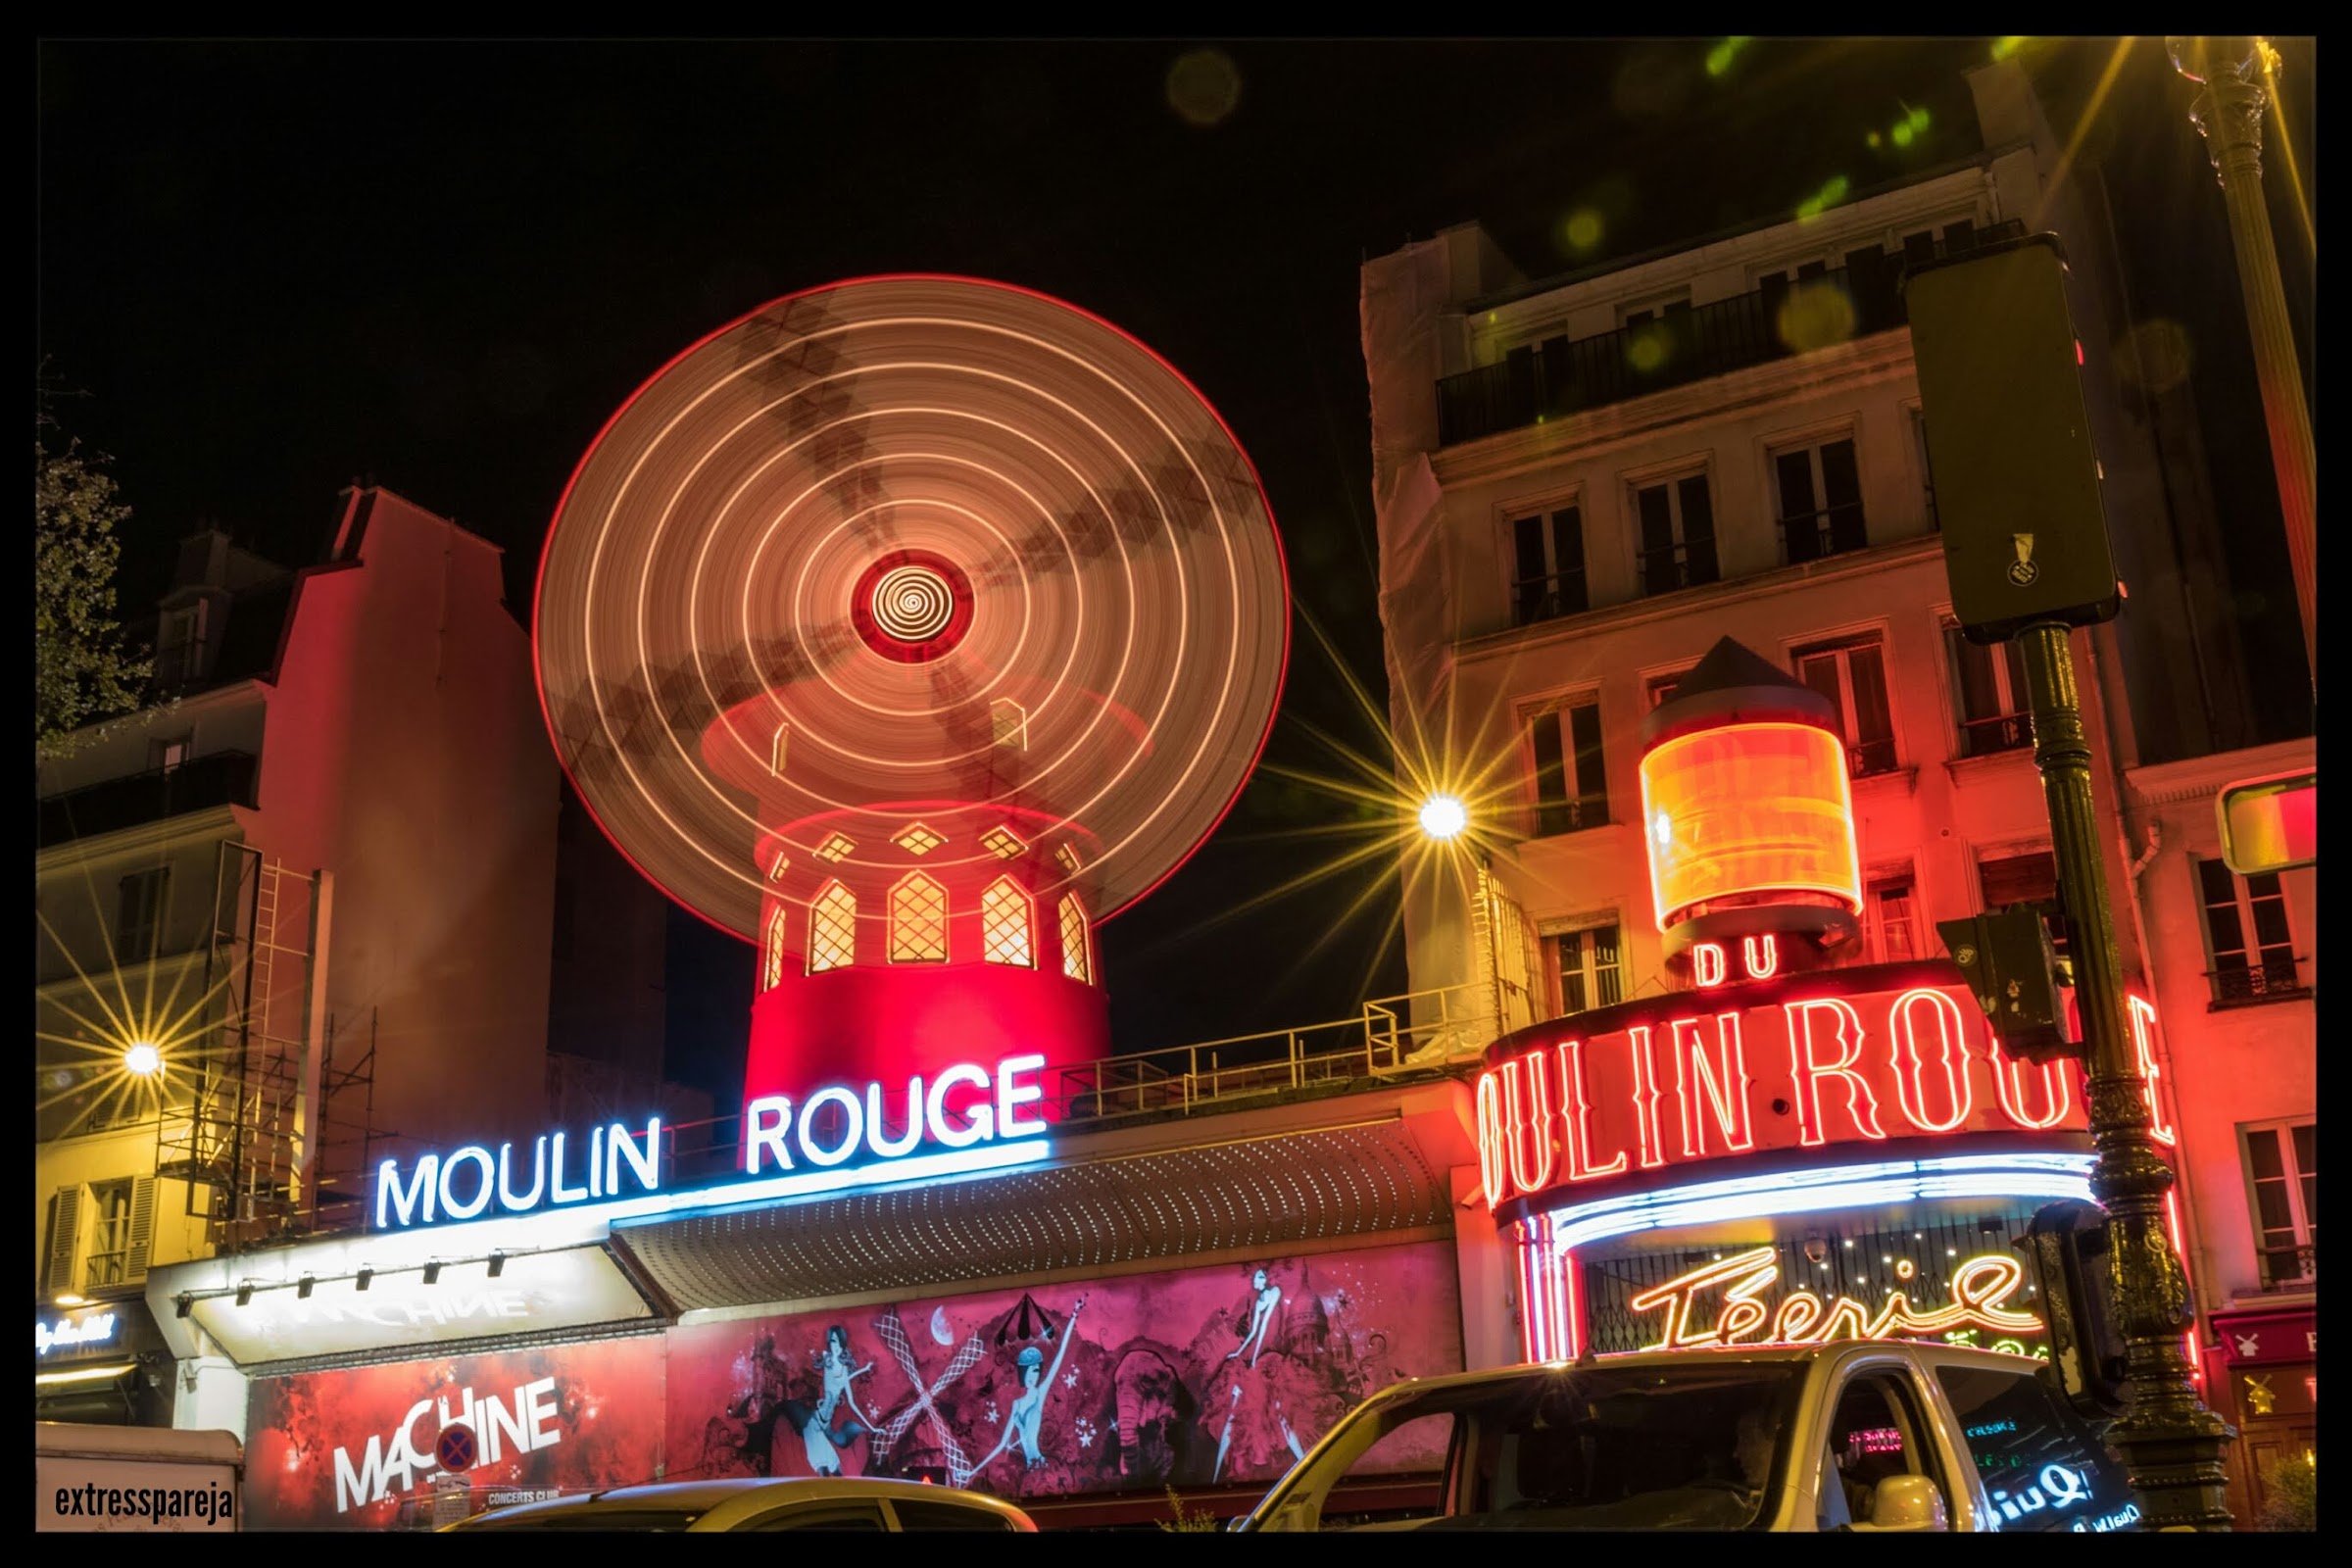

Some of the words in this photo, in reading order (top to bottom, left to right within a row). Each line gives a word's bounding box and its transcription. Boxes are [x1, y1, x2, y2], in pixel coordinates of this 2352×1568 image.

[1692, 934, 1777, 987] DU
[1784, 988, 2177, 1147] ROUE
[375, 1116, 662, 1229] MOULIN
[745, 1054, 1049, 1175] ROUGE
[333, 1376, 562, 1513] MACHINE
[488, 1490, 534, 1505] CONCERTS
